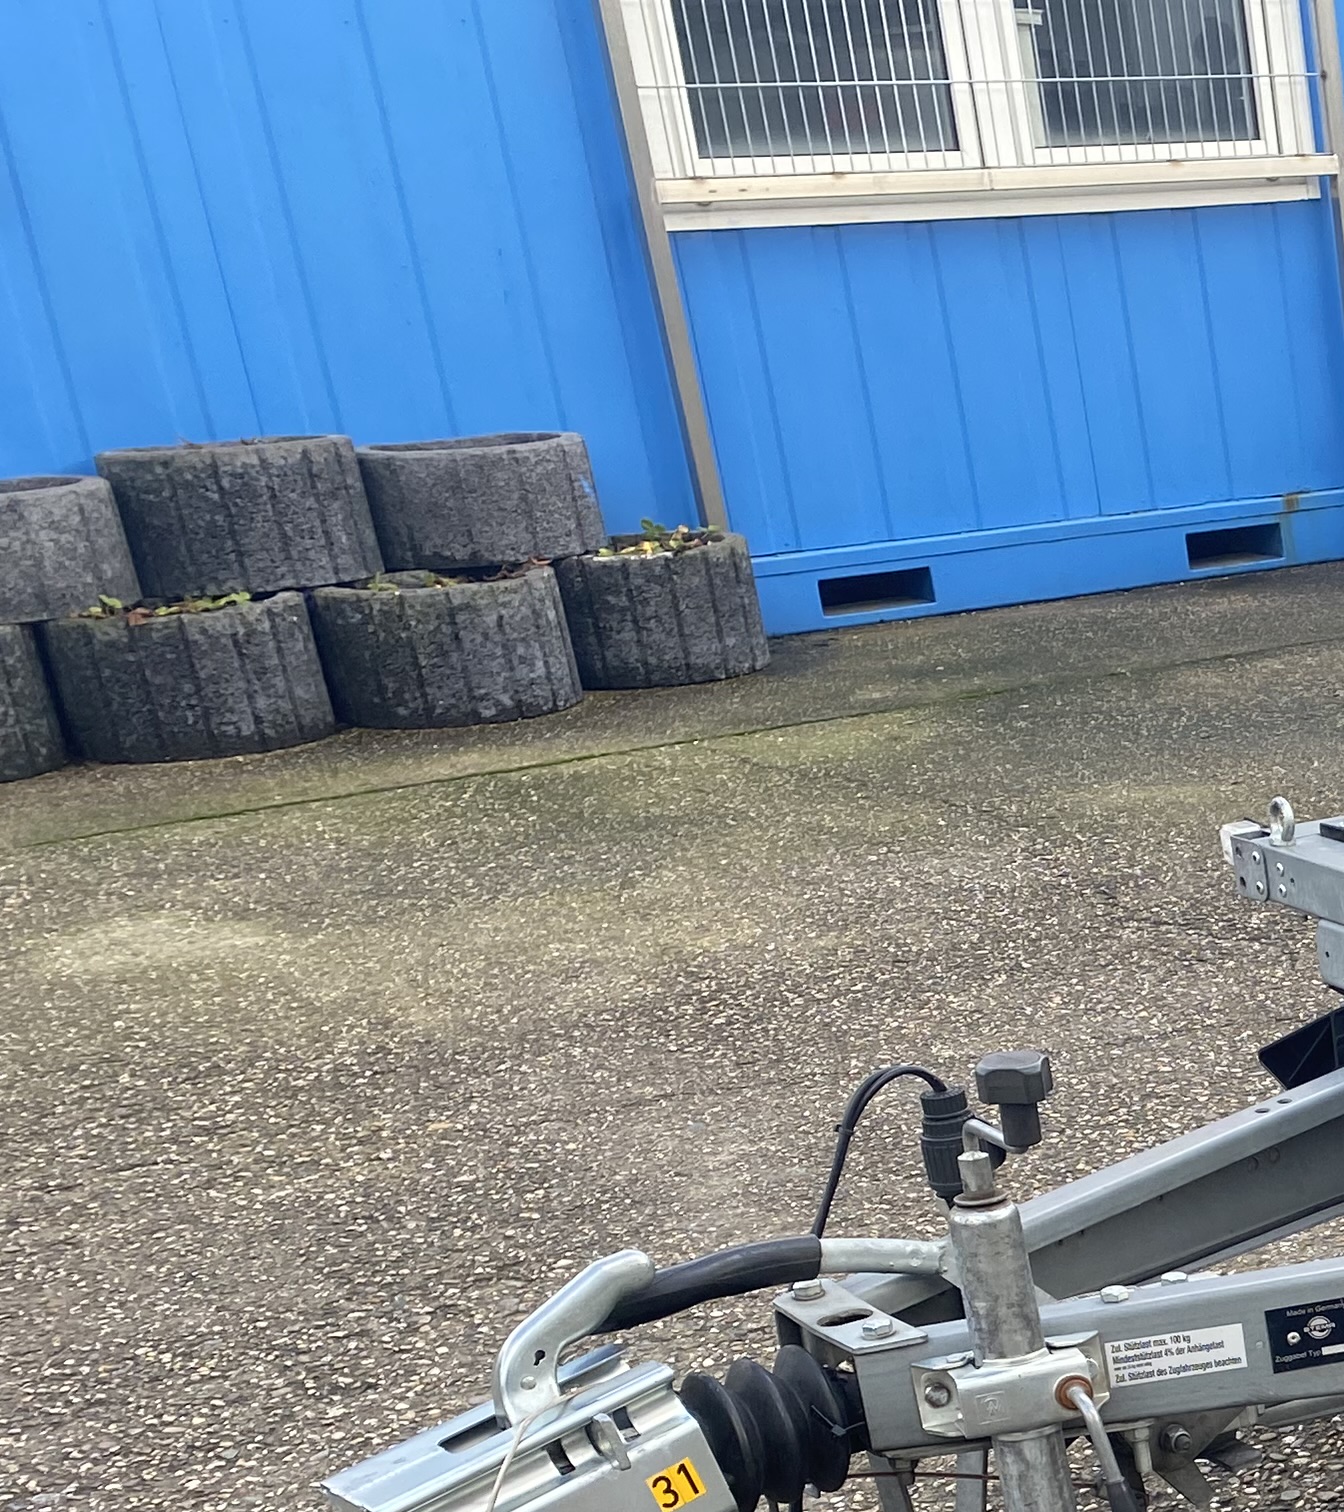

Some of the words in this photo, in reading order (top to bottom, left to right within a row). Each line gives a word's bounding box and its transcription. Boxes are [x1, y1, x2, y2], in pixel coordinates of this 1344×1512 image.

[1286, 1307, 1306, 1317] Made
[1169, 1335, 1182, 1345] 100
[1182, 1334, 1191, 1344] kg
[1175, 1346, 1186, 1356] der
[1308, 1348, 1322, 1358] Typ
[1156, 1367, 1168, 1377] des
[652, 1463, 700, 1508] 31
